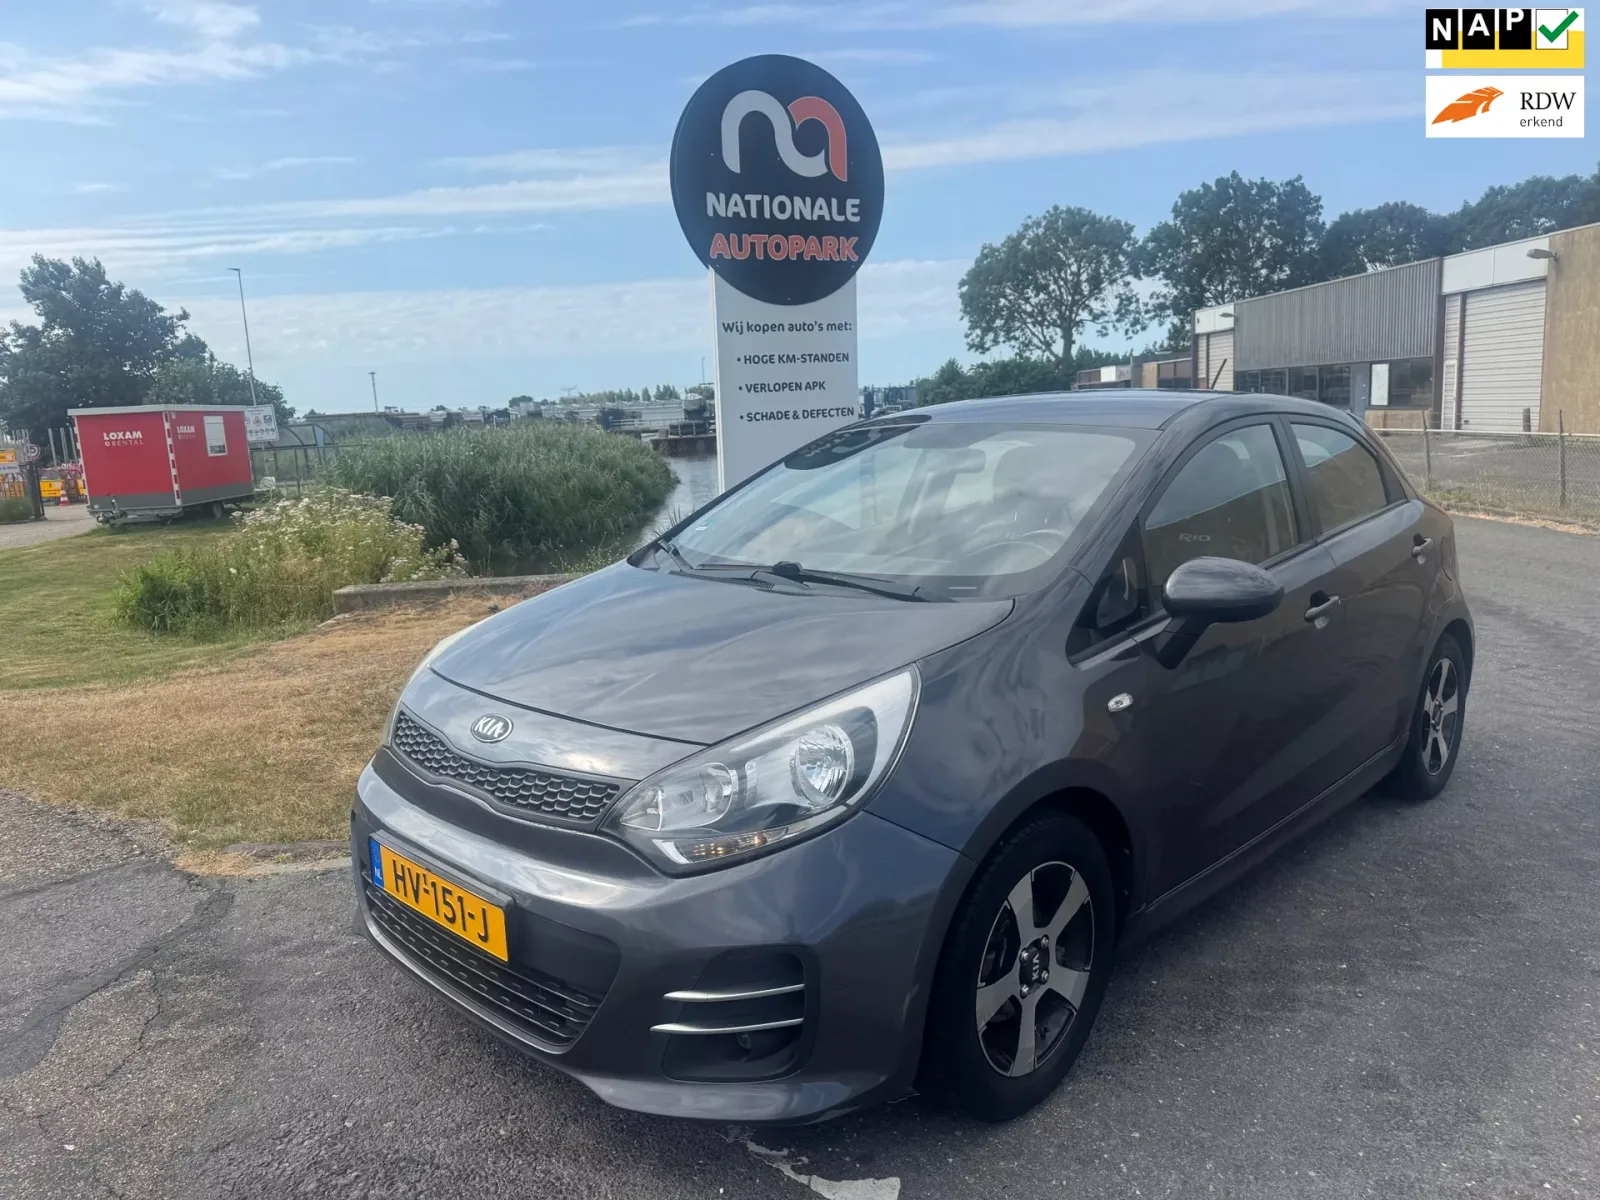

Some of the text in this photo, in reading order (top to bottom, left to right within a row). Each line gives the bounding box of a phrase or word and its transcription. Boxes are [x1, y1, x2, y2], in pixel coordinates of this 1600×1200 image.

[706, 192, 860, 222] NATIONALE
[710, 233, 859, 261] AUTOPARK
[722, 321, 852, 335] Wij kopen auto's met:
[744, 352, 850, 365] HOGE KM-STANDEN
[745, 381, 826, 393] VERLOPEN APK
[746, 407, 854, 422] SCHADE & DEFECTEN
[103, 430, 143, 440] LOXAM
[1179, 533, 1211, 542] RIO
[474, 716, 505, 738] KIA
[374, 866, 383, 880] NL
[392, 858, 489, 943] HV-151-J
